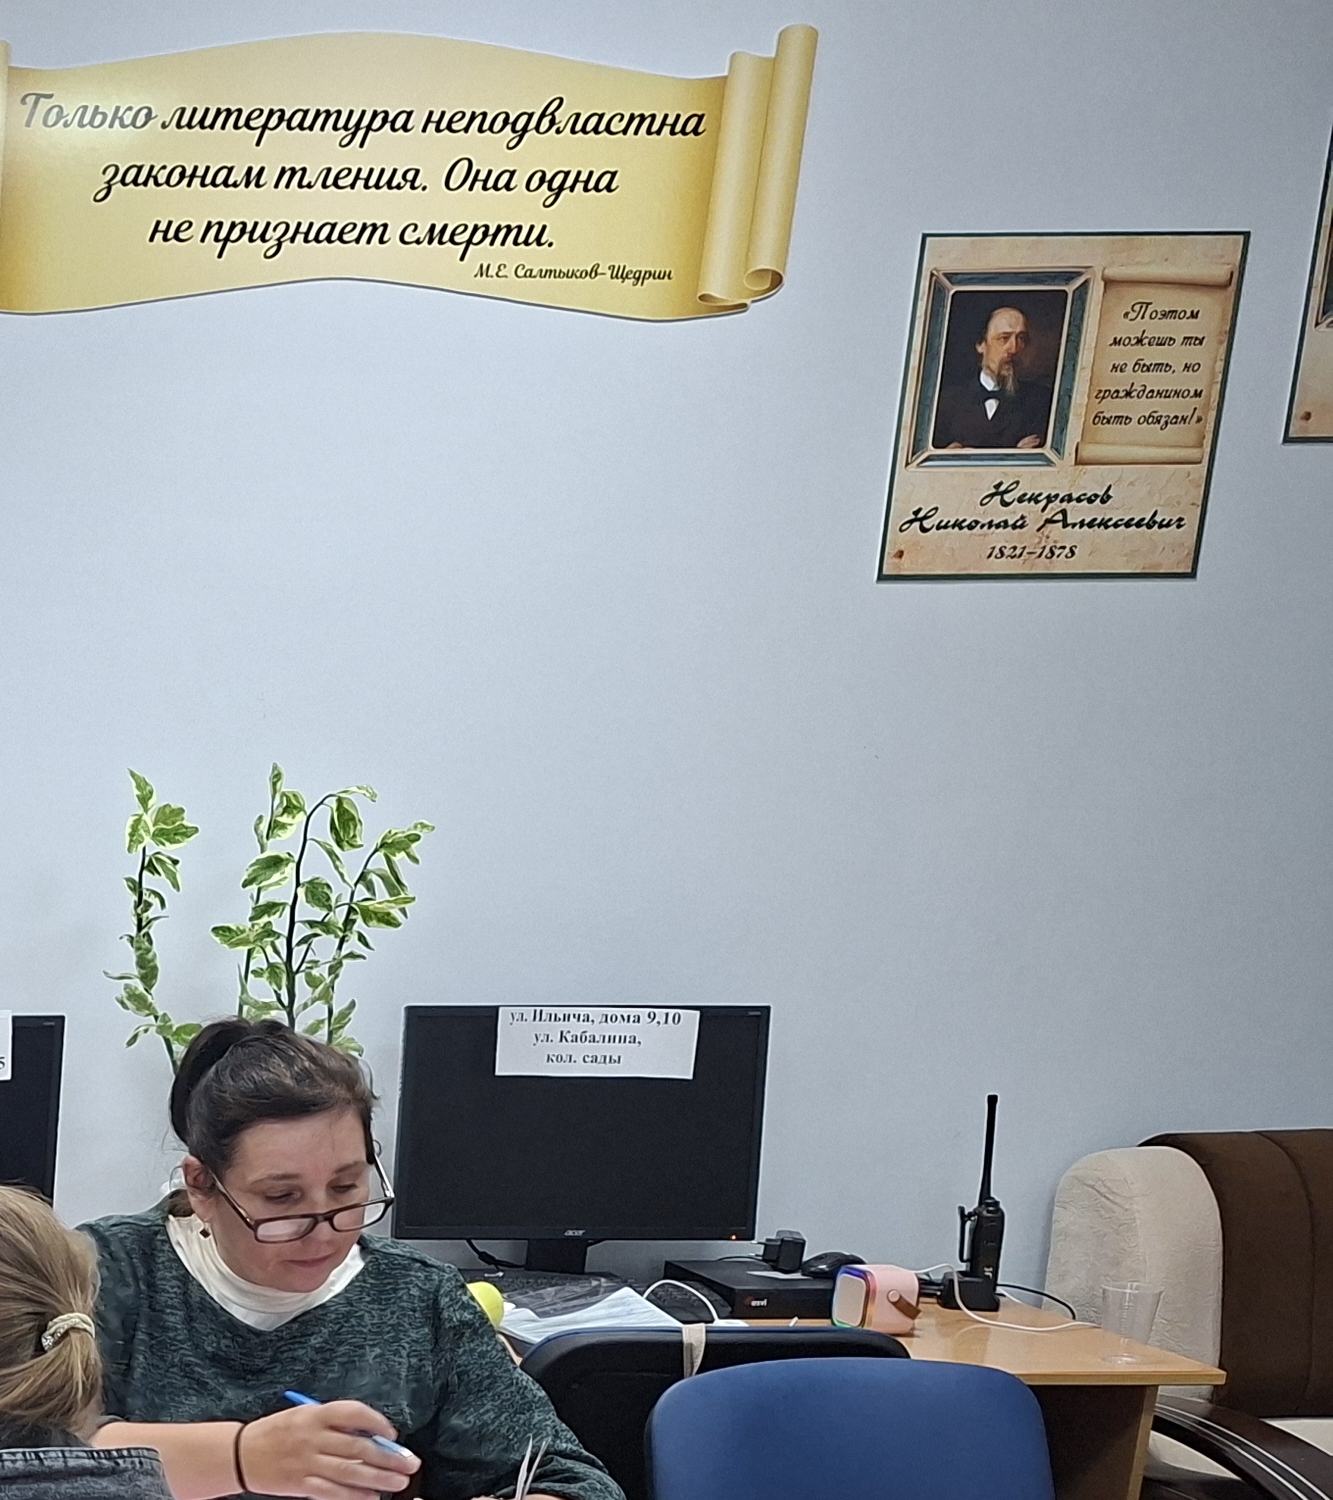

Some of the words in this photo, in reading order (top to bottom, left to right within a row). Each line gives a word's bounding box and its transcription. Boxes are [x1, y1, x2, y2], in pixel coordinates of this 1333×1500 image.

[20, 90, 157, 133] Только
[160, 104, 416, 149] литература
[422, 97, 707, 151] неподвластна
[95, 160, 267, 203] законам
[273, 163, 429, 192] тления.
[442, 158, 520, 195] Она
[526, 167, 620, 214] одна
[149, 220, 194, 247] не
[198, 219, 391, 260] признает
[398, 219, 555, 261] смерти.
[473, 263, 508, 279] М.Е.
[513, 265, 673, 286] Салтыков-Щедрин
[1122, 301, 1199, 322] «Поэтом
[1109, 332, 1176, 349] можешь
[1181, 334, 1205, 347] ты
[1110, 361, 1127, 373] не
[1132, 358, 1176, 375] быть,
[1183, 361, 1201, 373] но
[1094, 385, 1203, 404] гражданином
[1092, 412, 1133, 427] быть
[1137, 407, 1203, 430] обязан!»
[980, 480, 1113, 513] Некрасов
[899, 506, 1028, 533] Николай
[1036, 508, 1187, 533] Алексеевич
[986, 544, 1078, 560] 1821-1878
[509, 1011, 528, 1024] ул.
[532, 1009, 595, 1025] Ильича,
[599, 1011, 641, 1026] дома
[646, 1011, 682, 1026] 9,10
[533, 1031, 554, 1046] ул.
[559, 1029, 642, 1047] Кабалина,
[546, 1052, 577, 1064] кол.
[582, 1052, 622, 1066] сады
